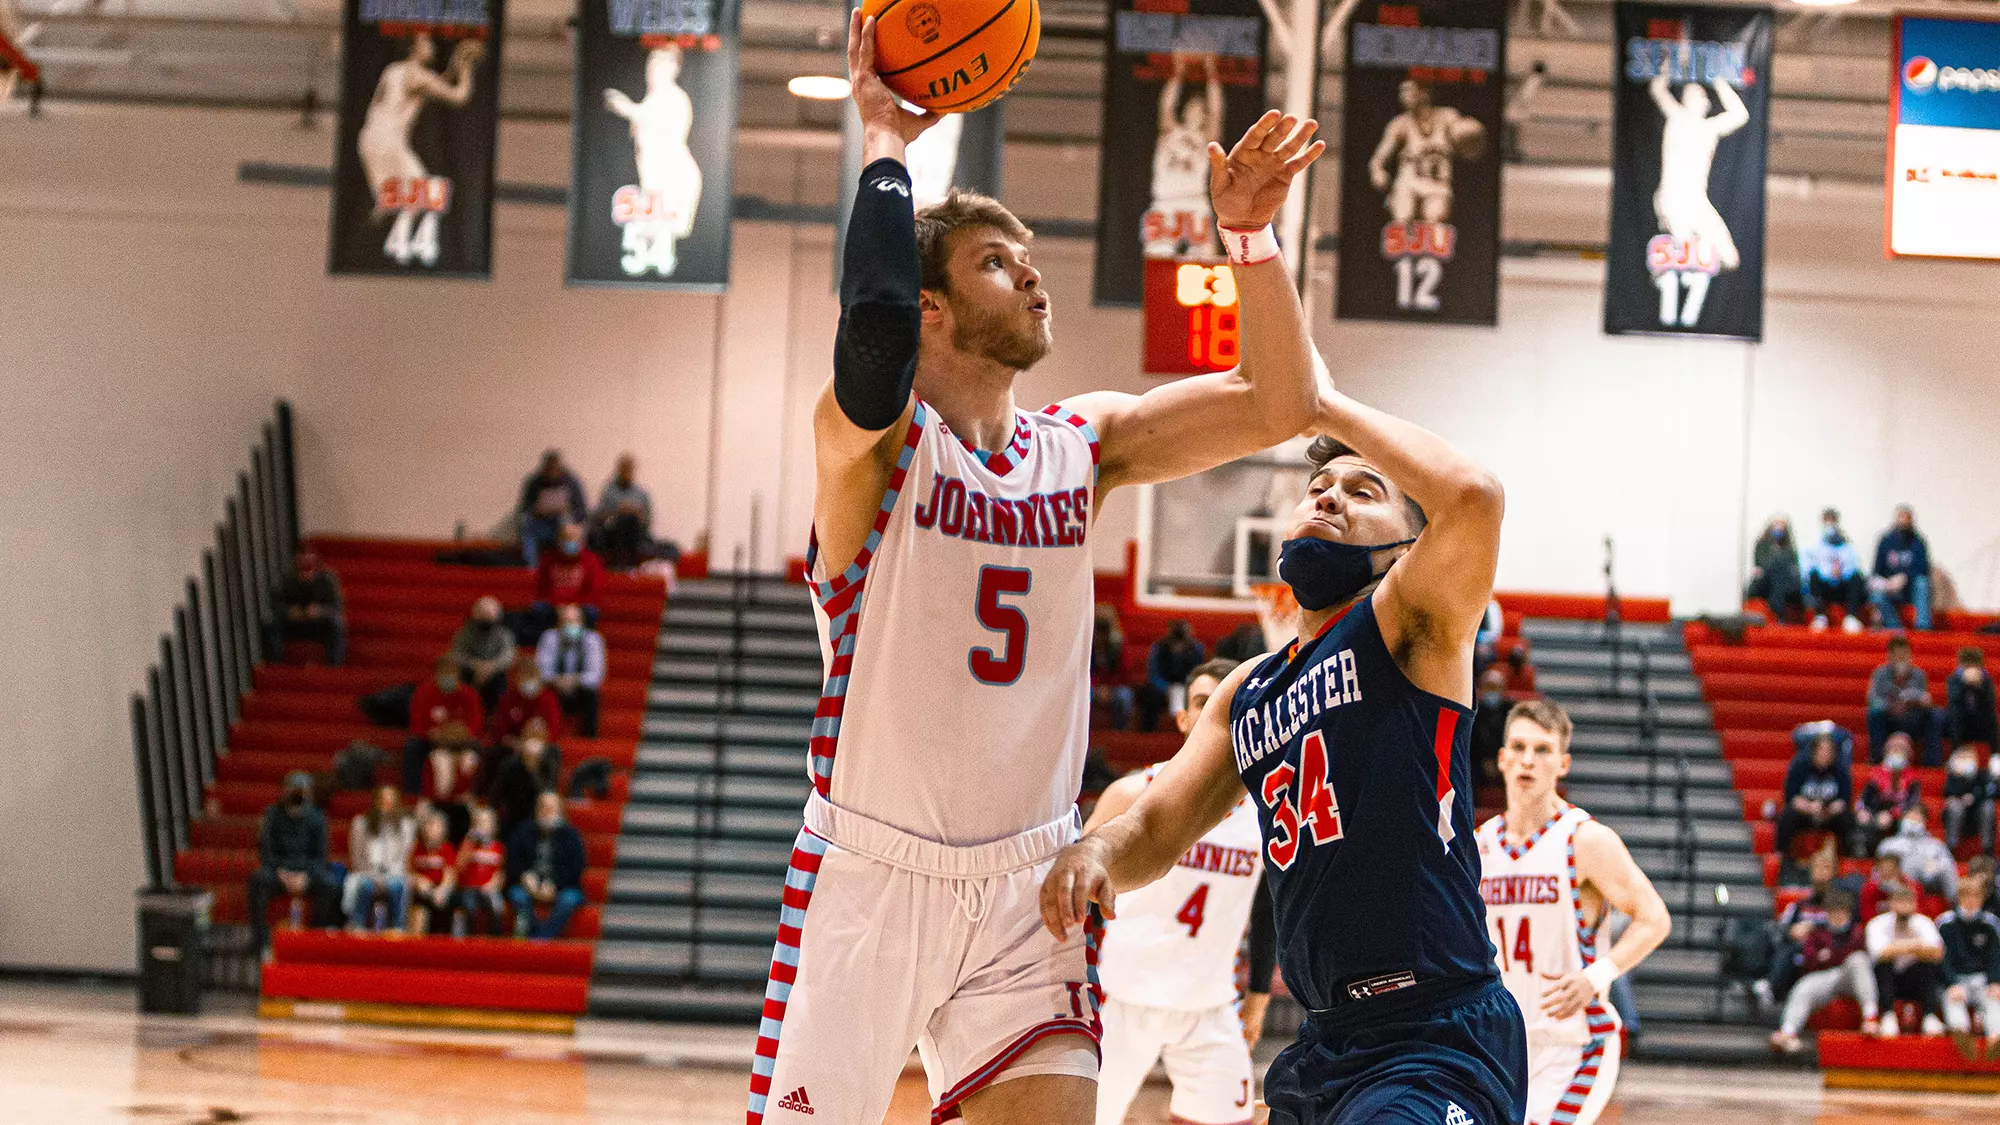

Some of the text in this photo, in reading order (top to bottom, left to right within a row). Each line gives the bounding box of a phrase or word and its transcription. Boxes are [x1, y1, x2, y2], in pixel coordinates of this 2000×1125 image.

[1936, 65, 2000, 94] peps
[611, 186, 679, 224] SJ
[383, 210, 441, 266] 44
[1381, 221, 1456, 260] SJU
[1396, 257, 1442, 309] 12
[1655, 270, 1711, 326] 17
[968, 563, 1033, 687] 5
[1261, 728, 1345, 873] 34
[1176, 841, 1259, 877] HNNIES
[1176, 883, 1210, 938] 4
[1481, 874, 1560, 906] OHNNIES
[1496, 915, 1533, 974] 14
[778, 1100, 815, 1115] adidas
[1234, 1079, 1249, 1108] J
